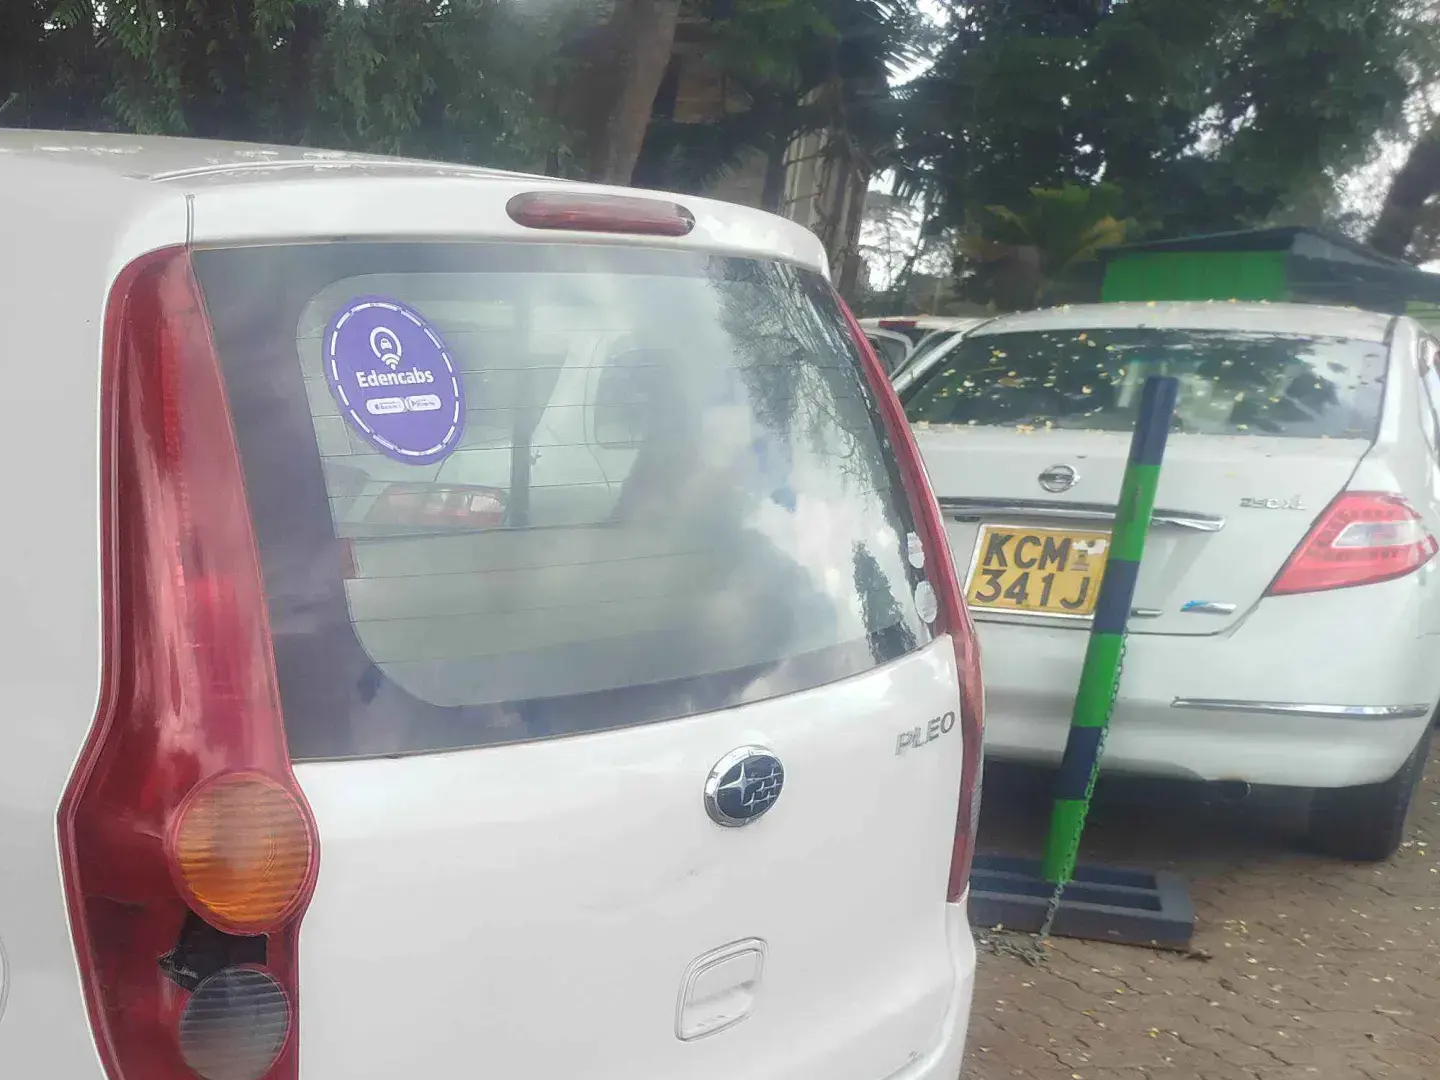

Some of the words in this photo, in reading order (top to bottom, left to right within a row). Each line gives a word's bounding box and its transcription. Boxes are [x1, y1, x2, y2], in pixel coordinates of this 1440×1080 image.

[356, 367, 434, 388] Edencabs
[982, 533, 1072, 572] KCM
[975, 569, 1091, 610] 341J
[895, 711, 956, 756] PLEO
